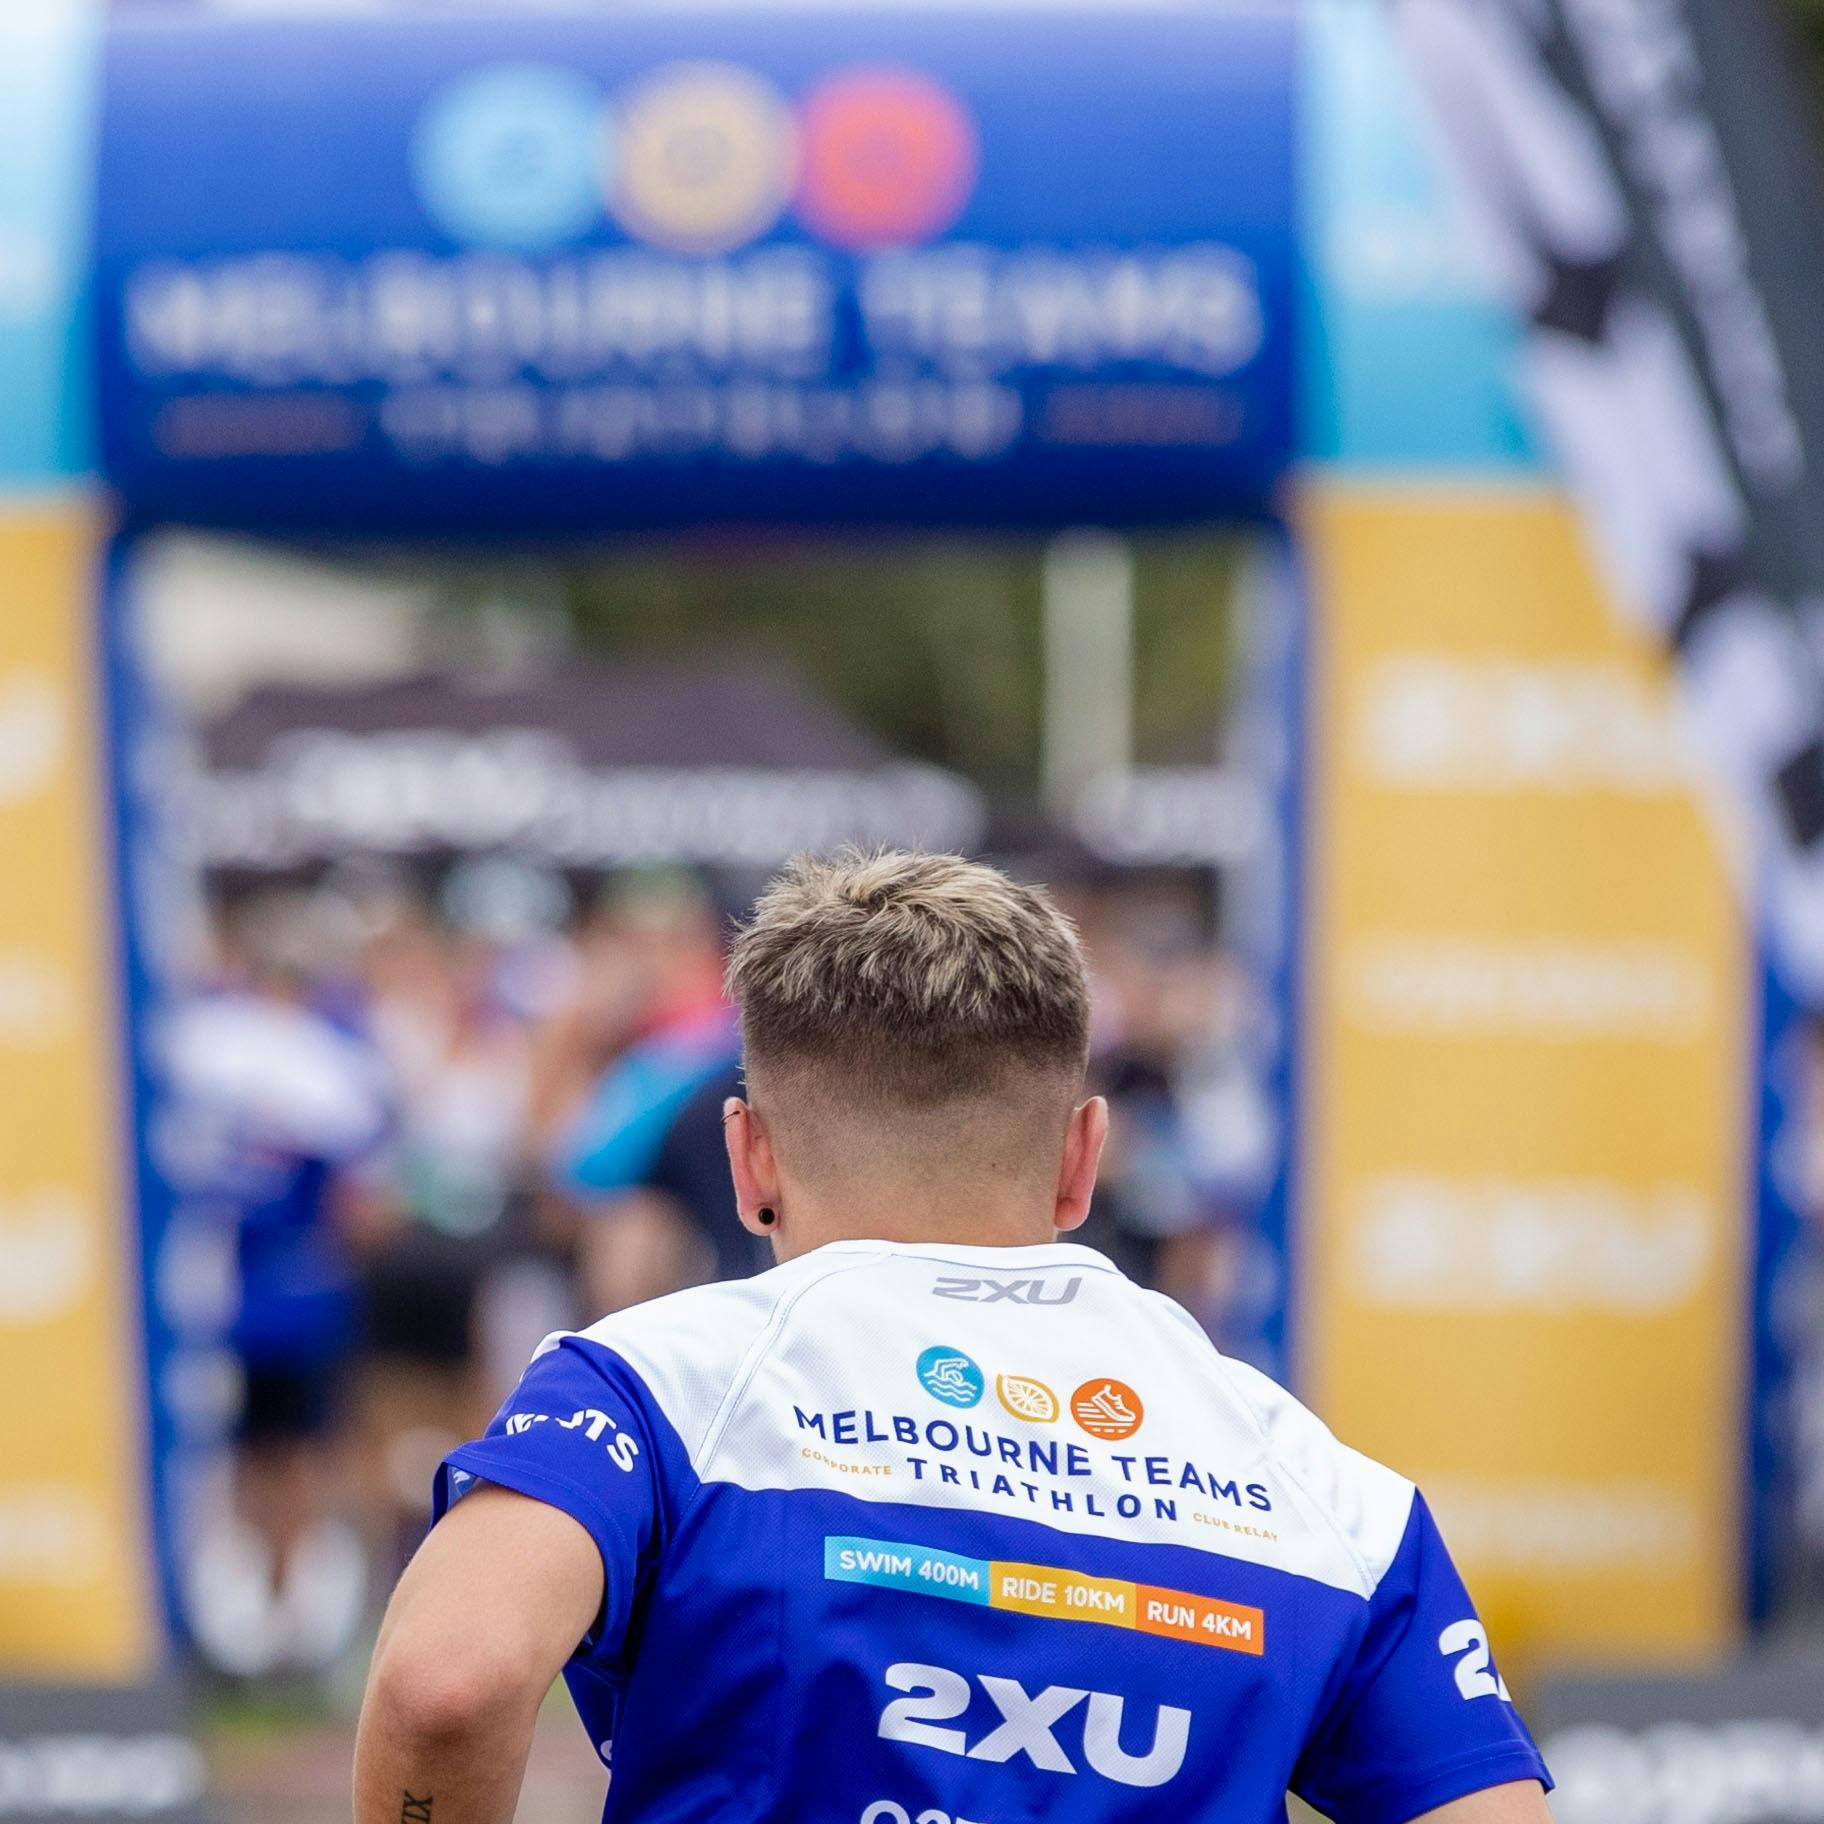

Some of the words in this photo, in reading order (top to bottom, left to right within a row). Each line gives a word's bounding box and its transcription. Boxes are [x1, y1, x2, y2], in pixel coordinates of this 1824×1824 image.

[932, 1277, 1081, 1305] 2XU
[793, 1405, 1092, 1476] MELBOURNE
[1112, 1455, 1272, 1512] TEAMS
[802, 1447, 892, 1475] CORPORATE
[907, 1457, 1177, 1522] TRIATHLON
[1193, 1512, 1230, 1531] CLUB
[1233, 1523, 1279, 1542] RELAY
[839, 1550, 912, 1578] SWIM
[919, 1561, 979, 1590] 400M
[1002, 1576, 1056, 1604] RIDE
[1065, 1585, 1125, 1613] 10KM
[1147, 1600, 1195, 1629] RUN
[1201, 1611, 1251, 1641] 4KM
[877, 1662, 1192, 1788] 2XU
